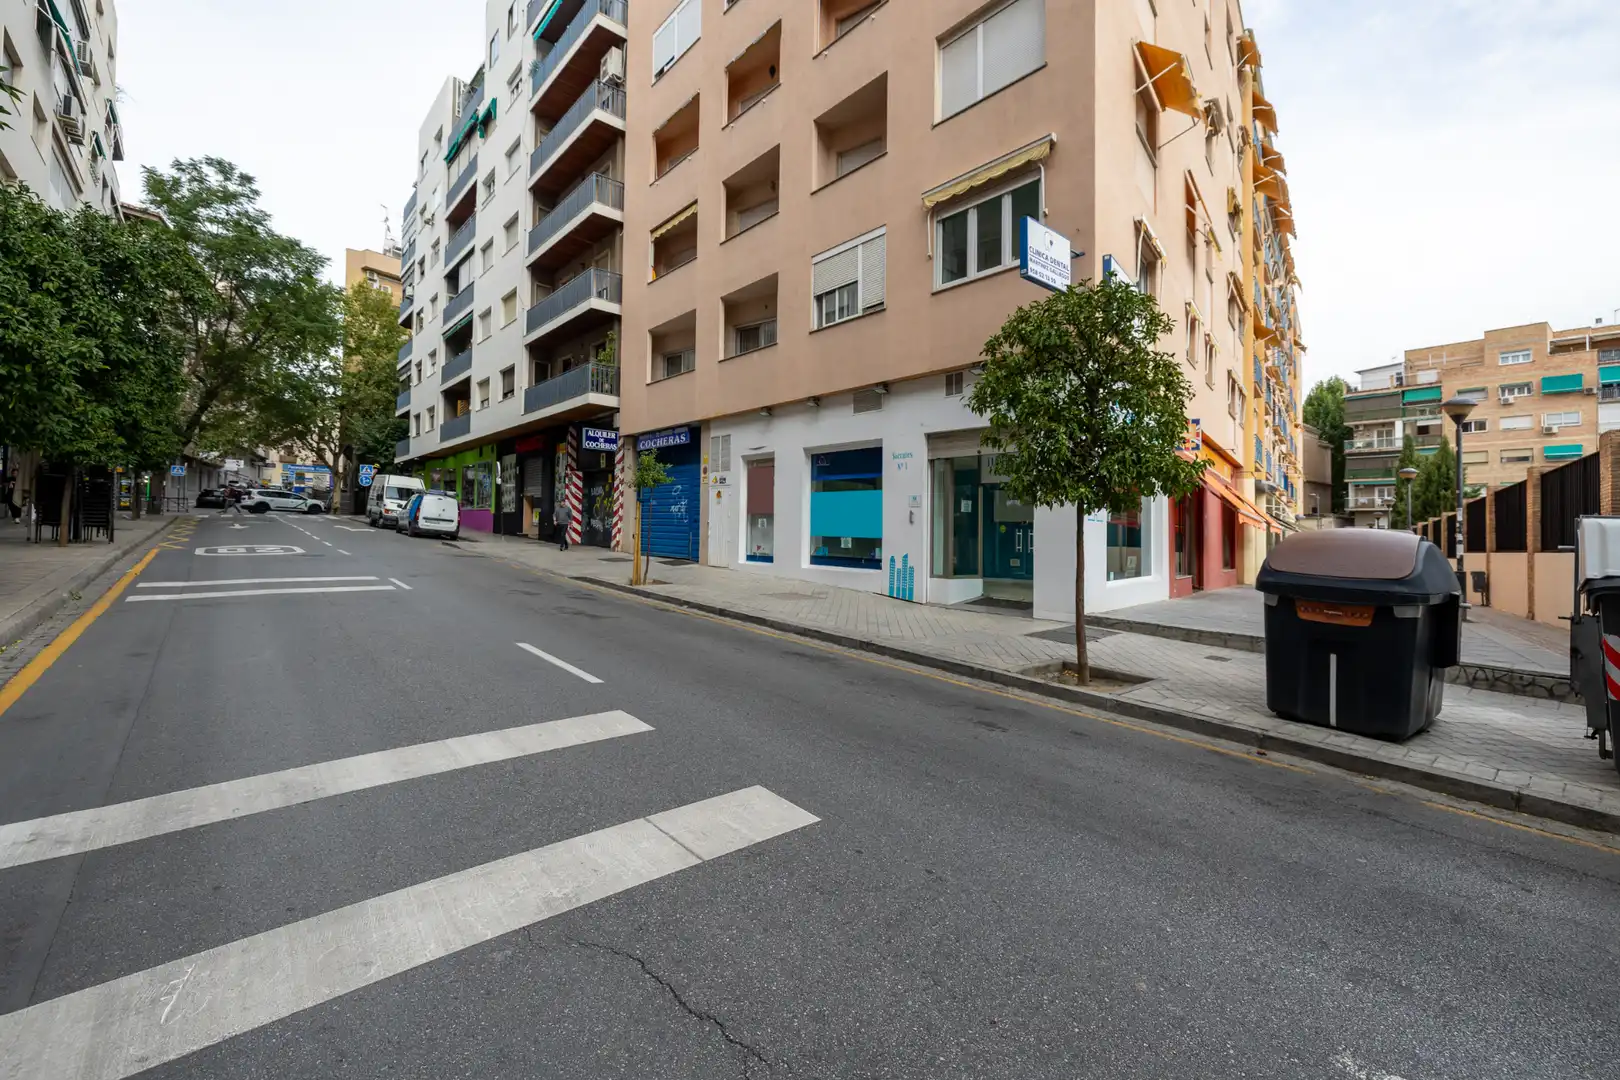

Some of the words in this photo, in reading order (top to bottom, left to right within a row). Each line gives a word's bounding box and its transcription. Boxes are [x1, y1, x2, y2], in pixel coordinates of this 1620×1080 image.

[1029, 246, 1049, 262] CLINICA
[1050, 257, 1070, 272] DENTAL
[587, 430, 616, 439] ALQUILER
[585, 441, 617, 450] COCHERAS
[639, 433, 686, 449] COCHERAS
